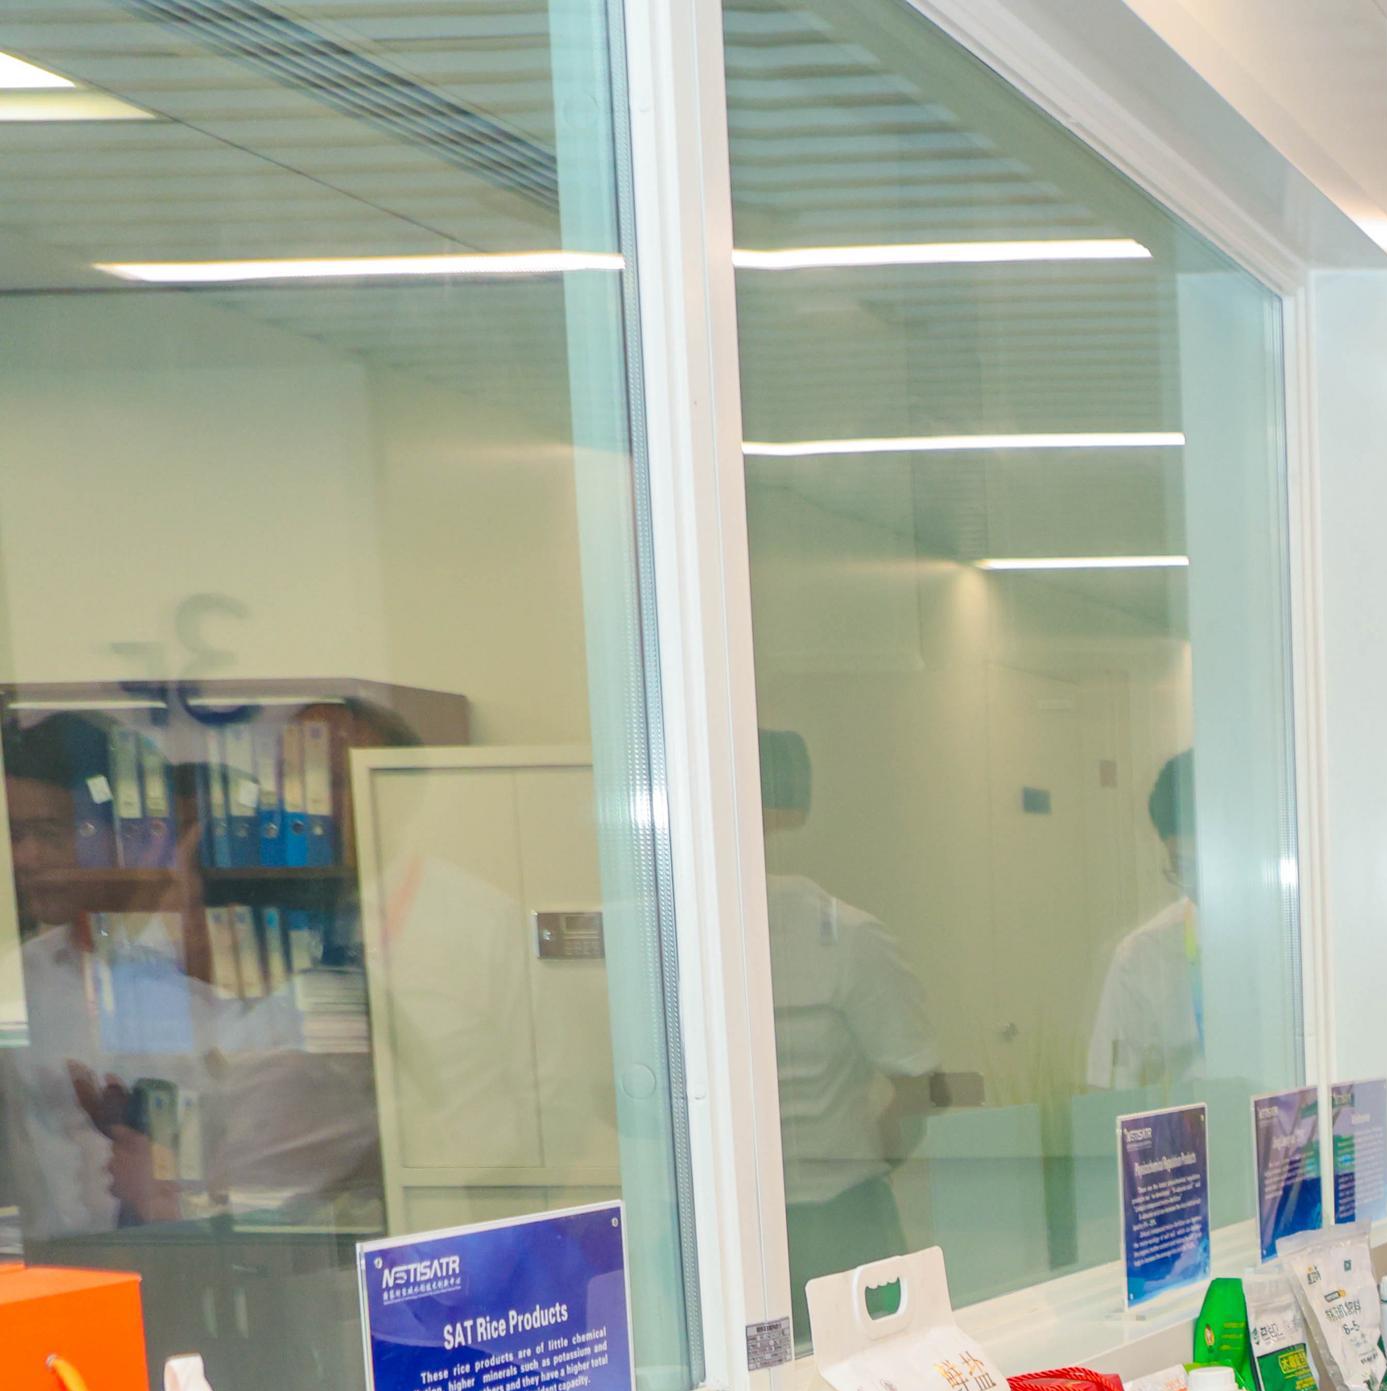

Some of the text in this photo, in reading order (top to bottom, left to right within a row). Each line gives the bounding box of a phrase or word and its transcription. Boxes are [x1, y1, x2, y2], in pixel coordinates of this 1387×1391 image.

[382, 1255, 460, 1289] NSTISATR
[443, 1302, 568, 1351] SAT Rice Products
[421, 1326, 607, 1385] These rice products are of little chemical
[483, 1365, 518, 1384] minerals
[520, 1358, 539, 1373] such
[542, 1356, 551, 1366] as
[553, 1344, 591, 1366] potassium
[594, 1340, 608, 1353] and
[506, 1378, 521, 1391] and
[522, 1372, 540, 1387] they
[540, 1368, 559, 1382] have
[560, 1367, 566, 1377] a
[566, 1359, 590, 1376] higher
[591, 1354, 608, 1369] total
